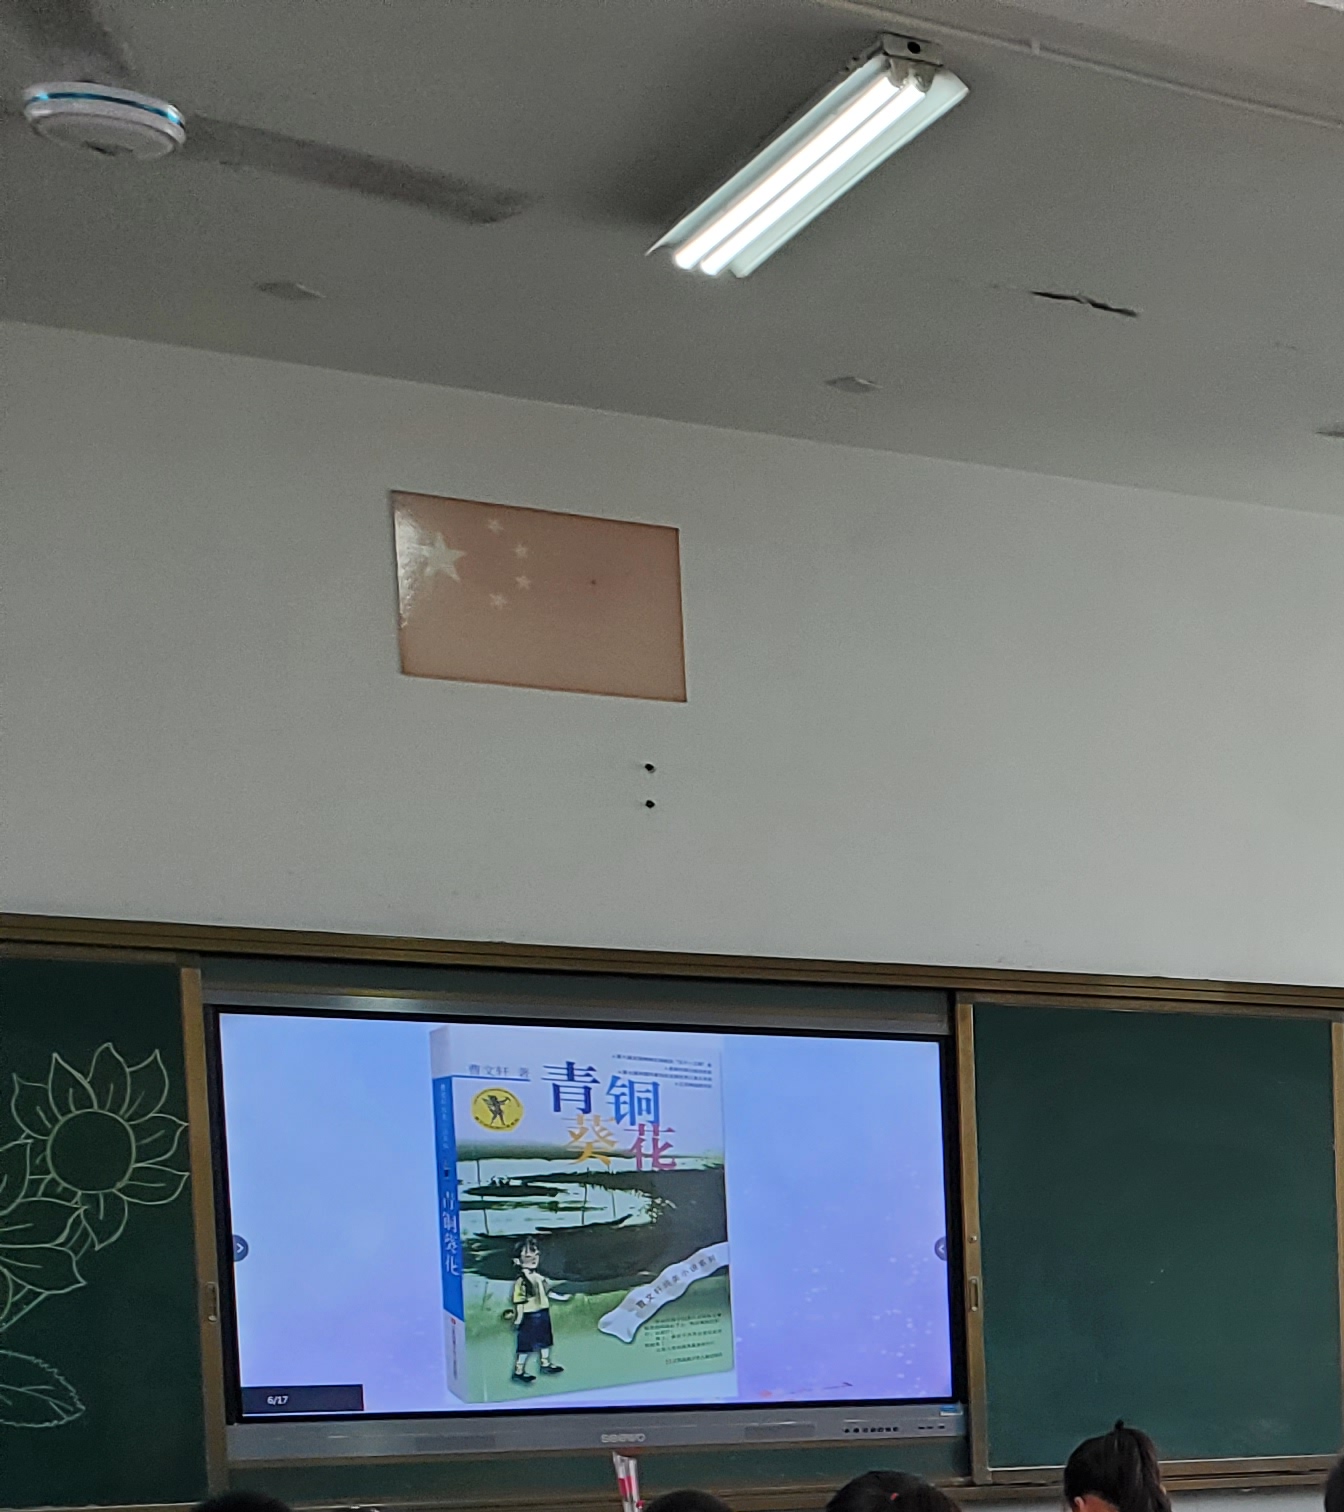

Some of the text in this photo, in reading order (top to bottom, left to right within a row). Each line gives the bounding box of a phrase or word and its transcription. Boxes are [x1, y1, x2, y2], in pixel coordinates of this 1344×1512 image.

[541, 1061, 661, 1127] 青铜
[560, 1113, 678, 1171] 葵花
[267, 1395, 289, 1406] 6/17
